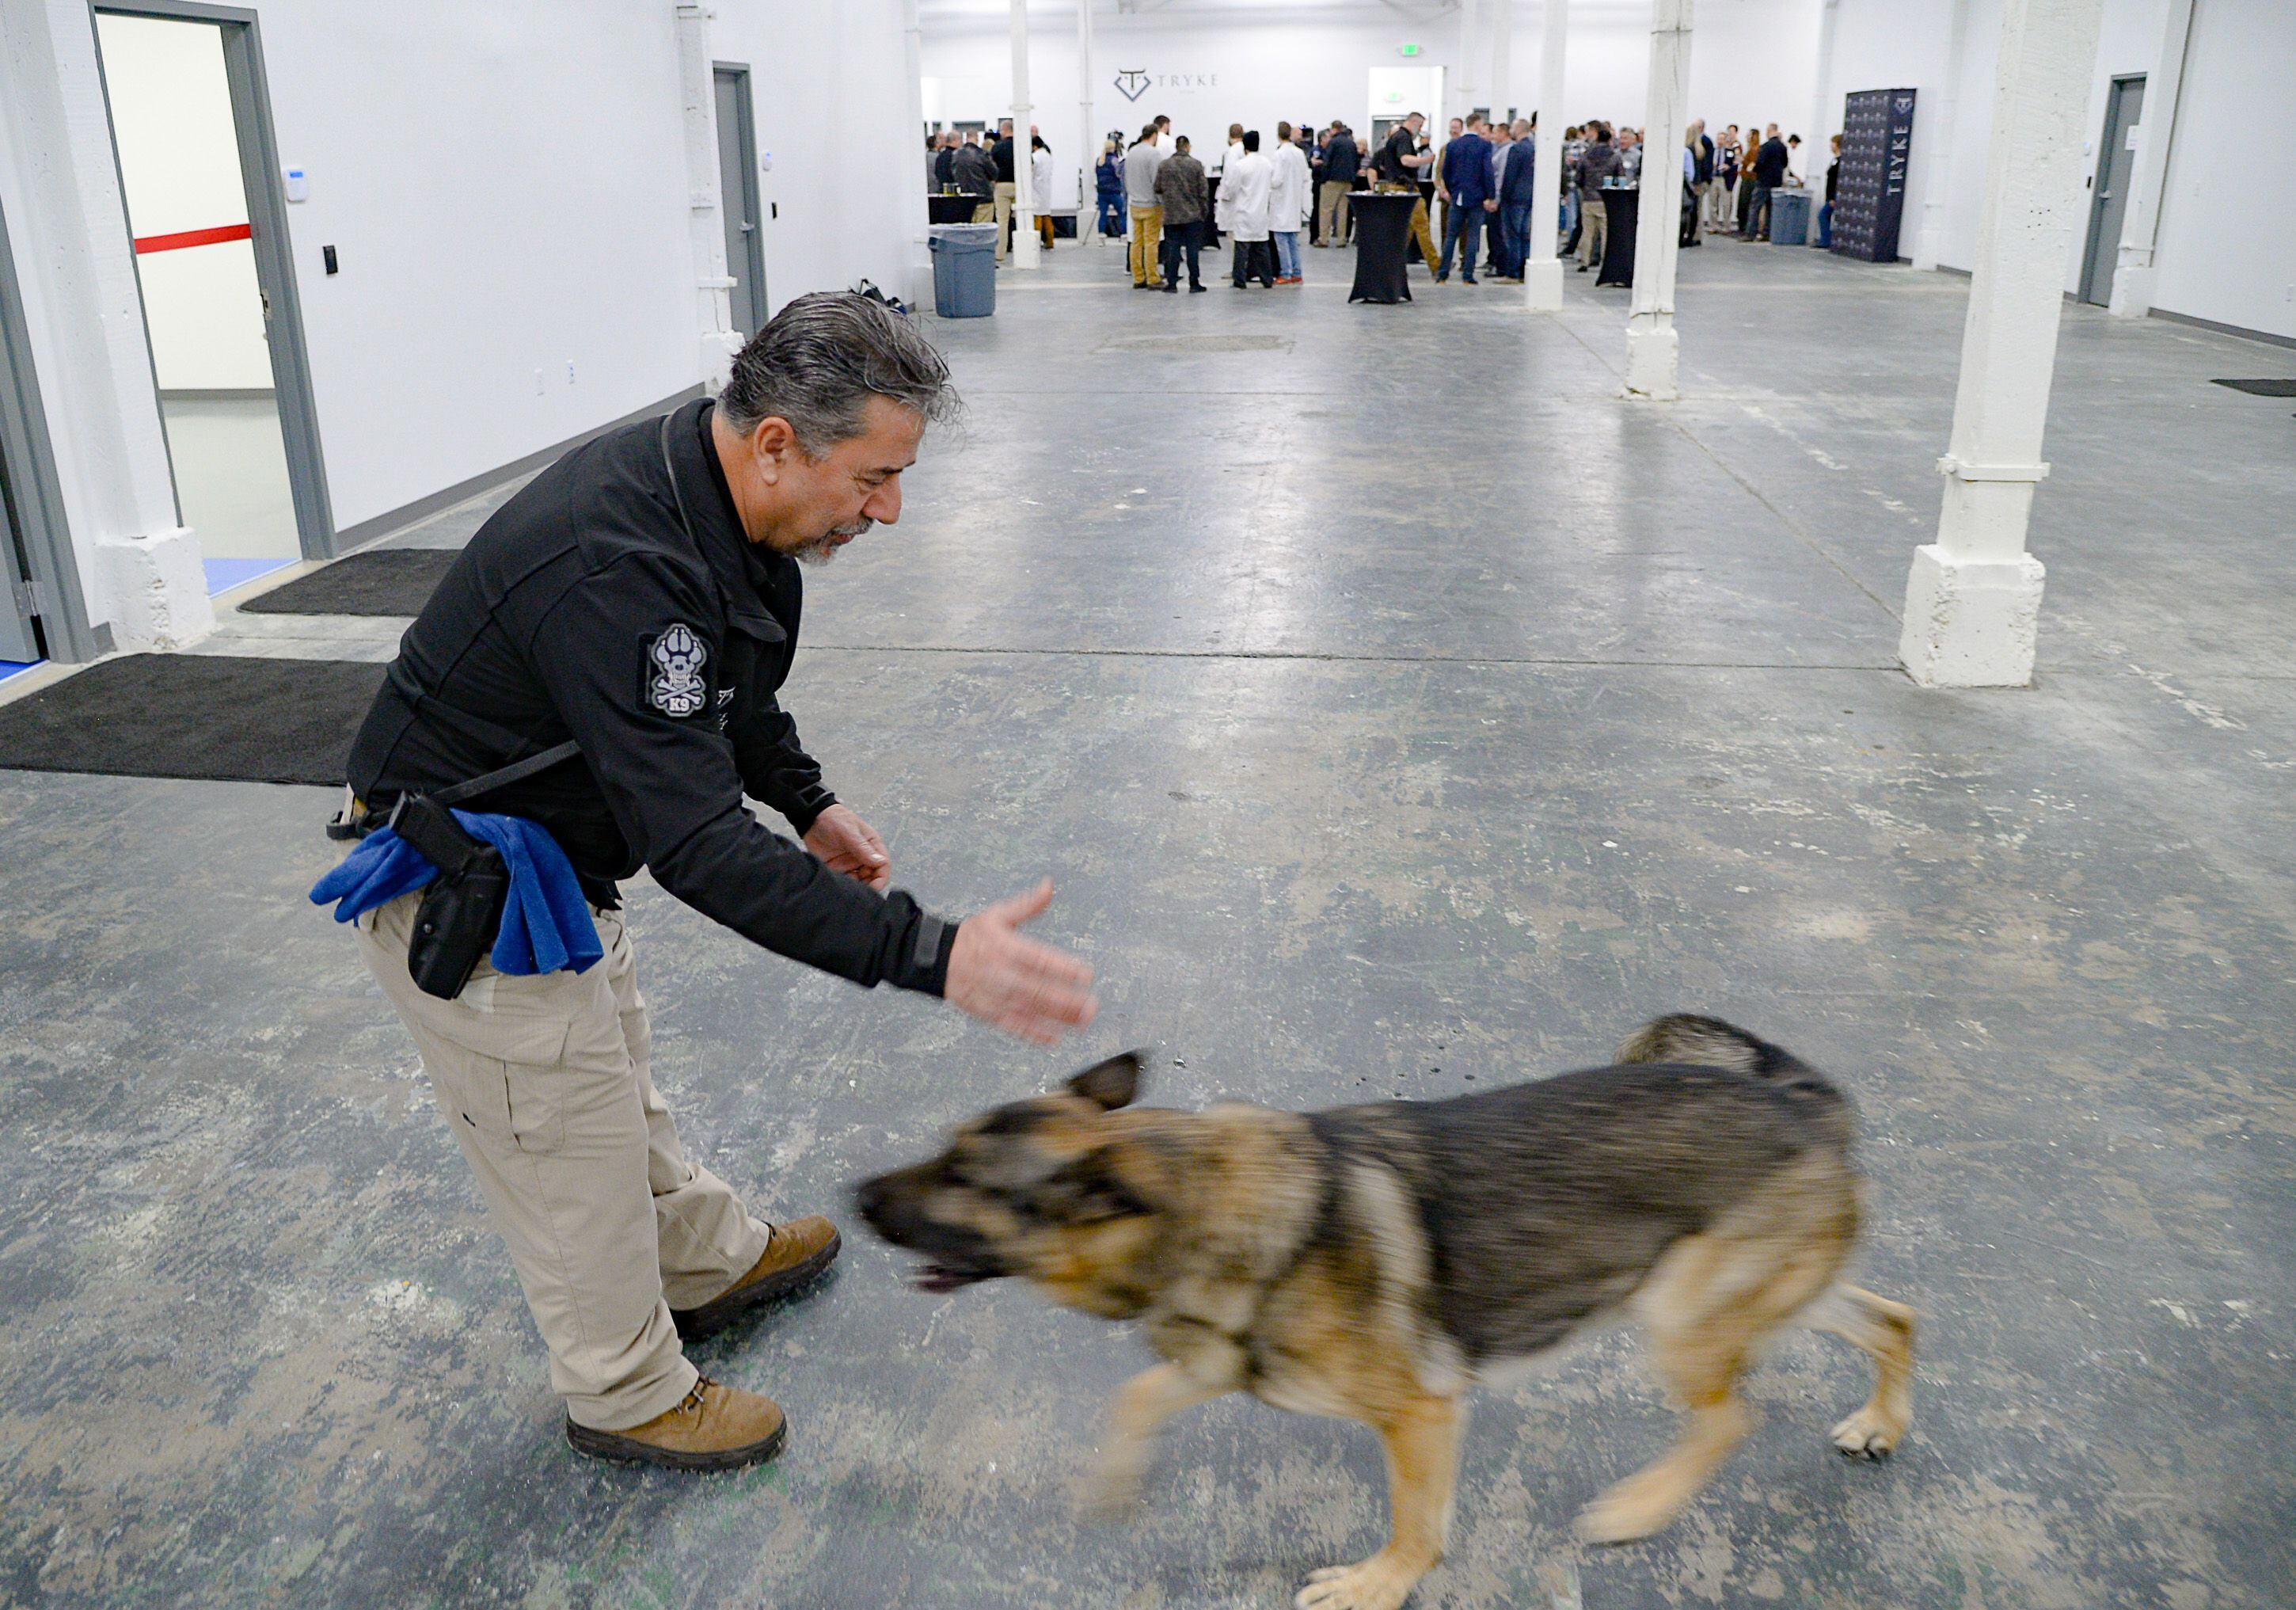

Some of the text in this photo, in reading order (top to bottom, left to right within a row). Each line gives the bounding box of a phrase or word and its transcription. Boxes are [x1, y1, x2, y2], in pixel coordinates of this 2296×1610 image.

[1157, 74, 1218, 86] TRYKE
[1887, 125, 1908, 196] TRYKE
[669, 698, 690, 712] K9
